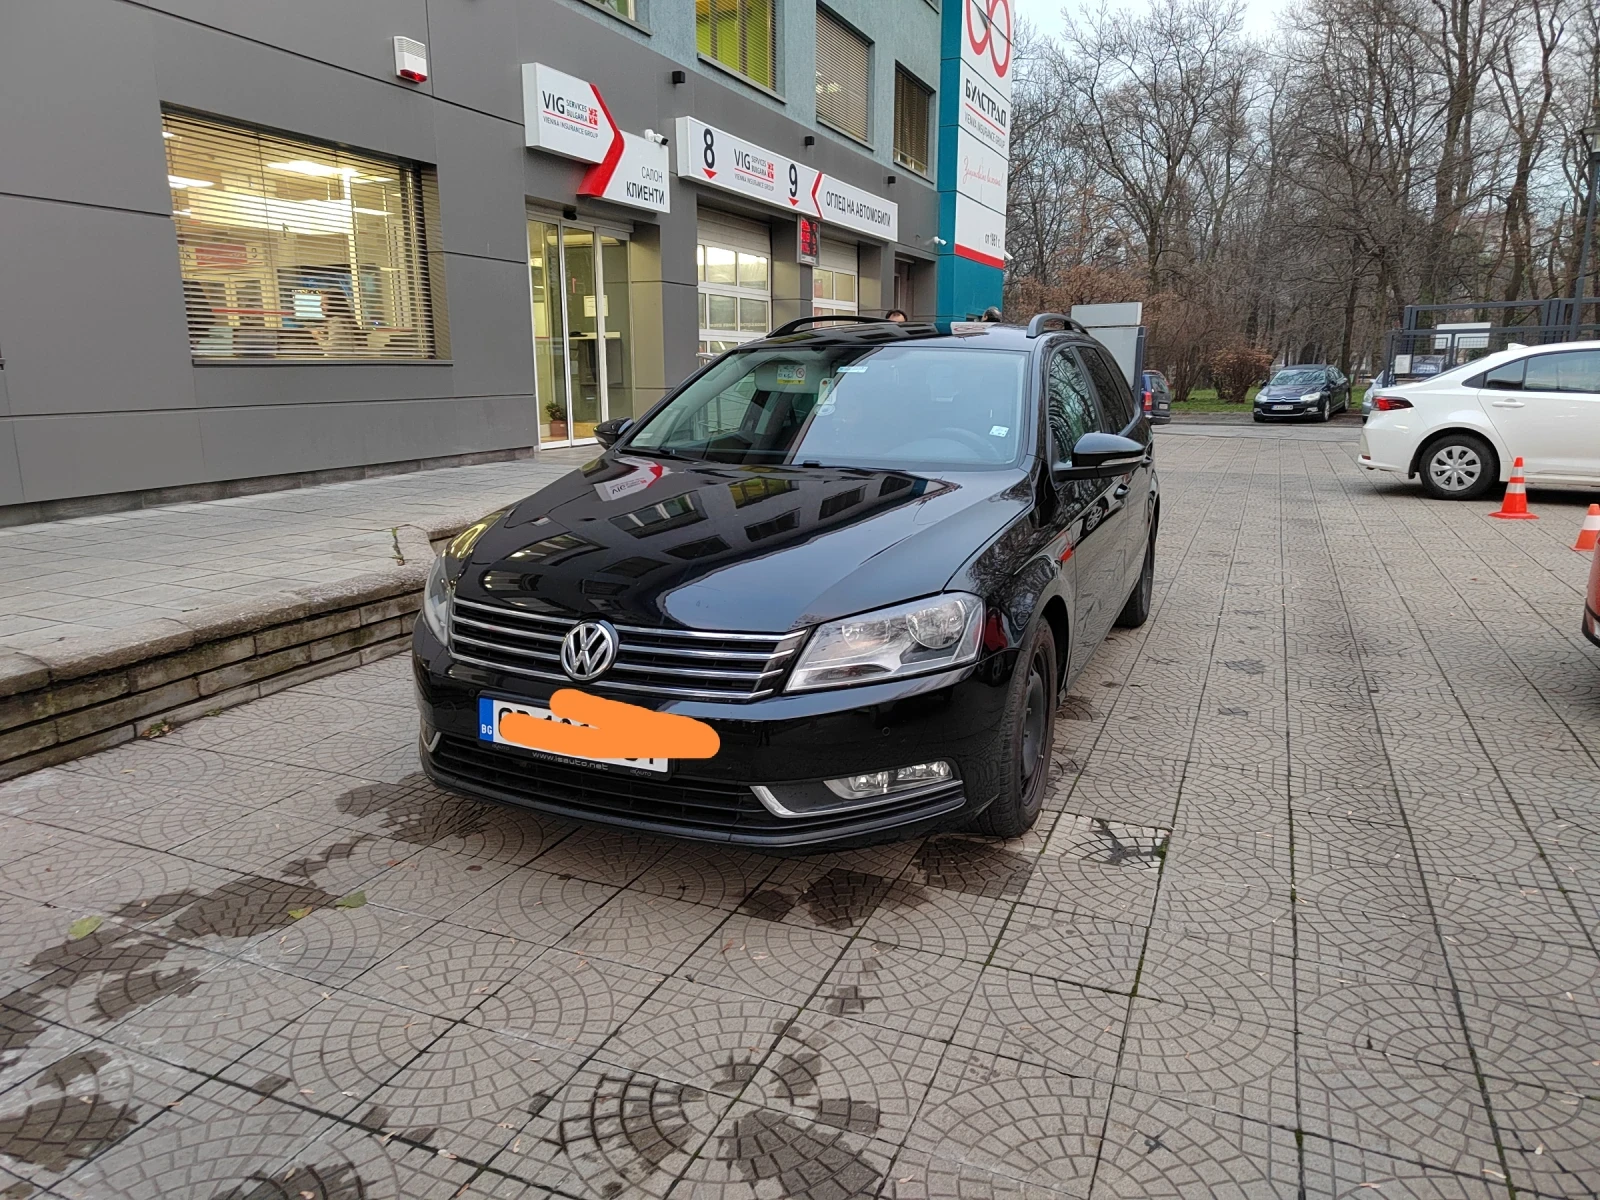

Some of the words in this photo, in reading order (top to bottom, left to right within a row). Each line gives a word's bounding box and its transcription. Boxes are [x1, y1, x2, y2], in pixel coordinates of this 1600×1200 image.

[542, 90, 565, 115] VIG
[566, 99, 588, 113] SERVICES
[965, 77, 1007, 128] БУЛСТРАД
[543, 115, 559, 127] VIENNA
[560, 121, 584, 135] INSURANCE
[584, 129, 599, 139] GROUP
[566, 109, 588, 122] BULGARIA
[703, 128, 715, 169] 8
[734, 148, 751, 171] VIG
[641, 166, 663, 183] САЛОН
[788, 163, 798, 198] 9
[626, 180, 665, 206] КЛИЕНТИ
[826, 190, 847, 215] ОГЛЕД
[847, 198, 855, 215] НА
[855, 202, 891, 227] АВТОМОБИЛИ
[481, 724, 493, 735] BG
[532, 751, 609, 771] www.isauto.net
